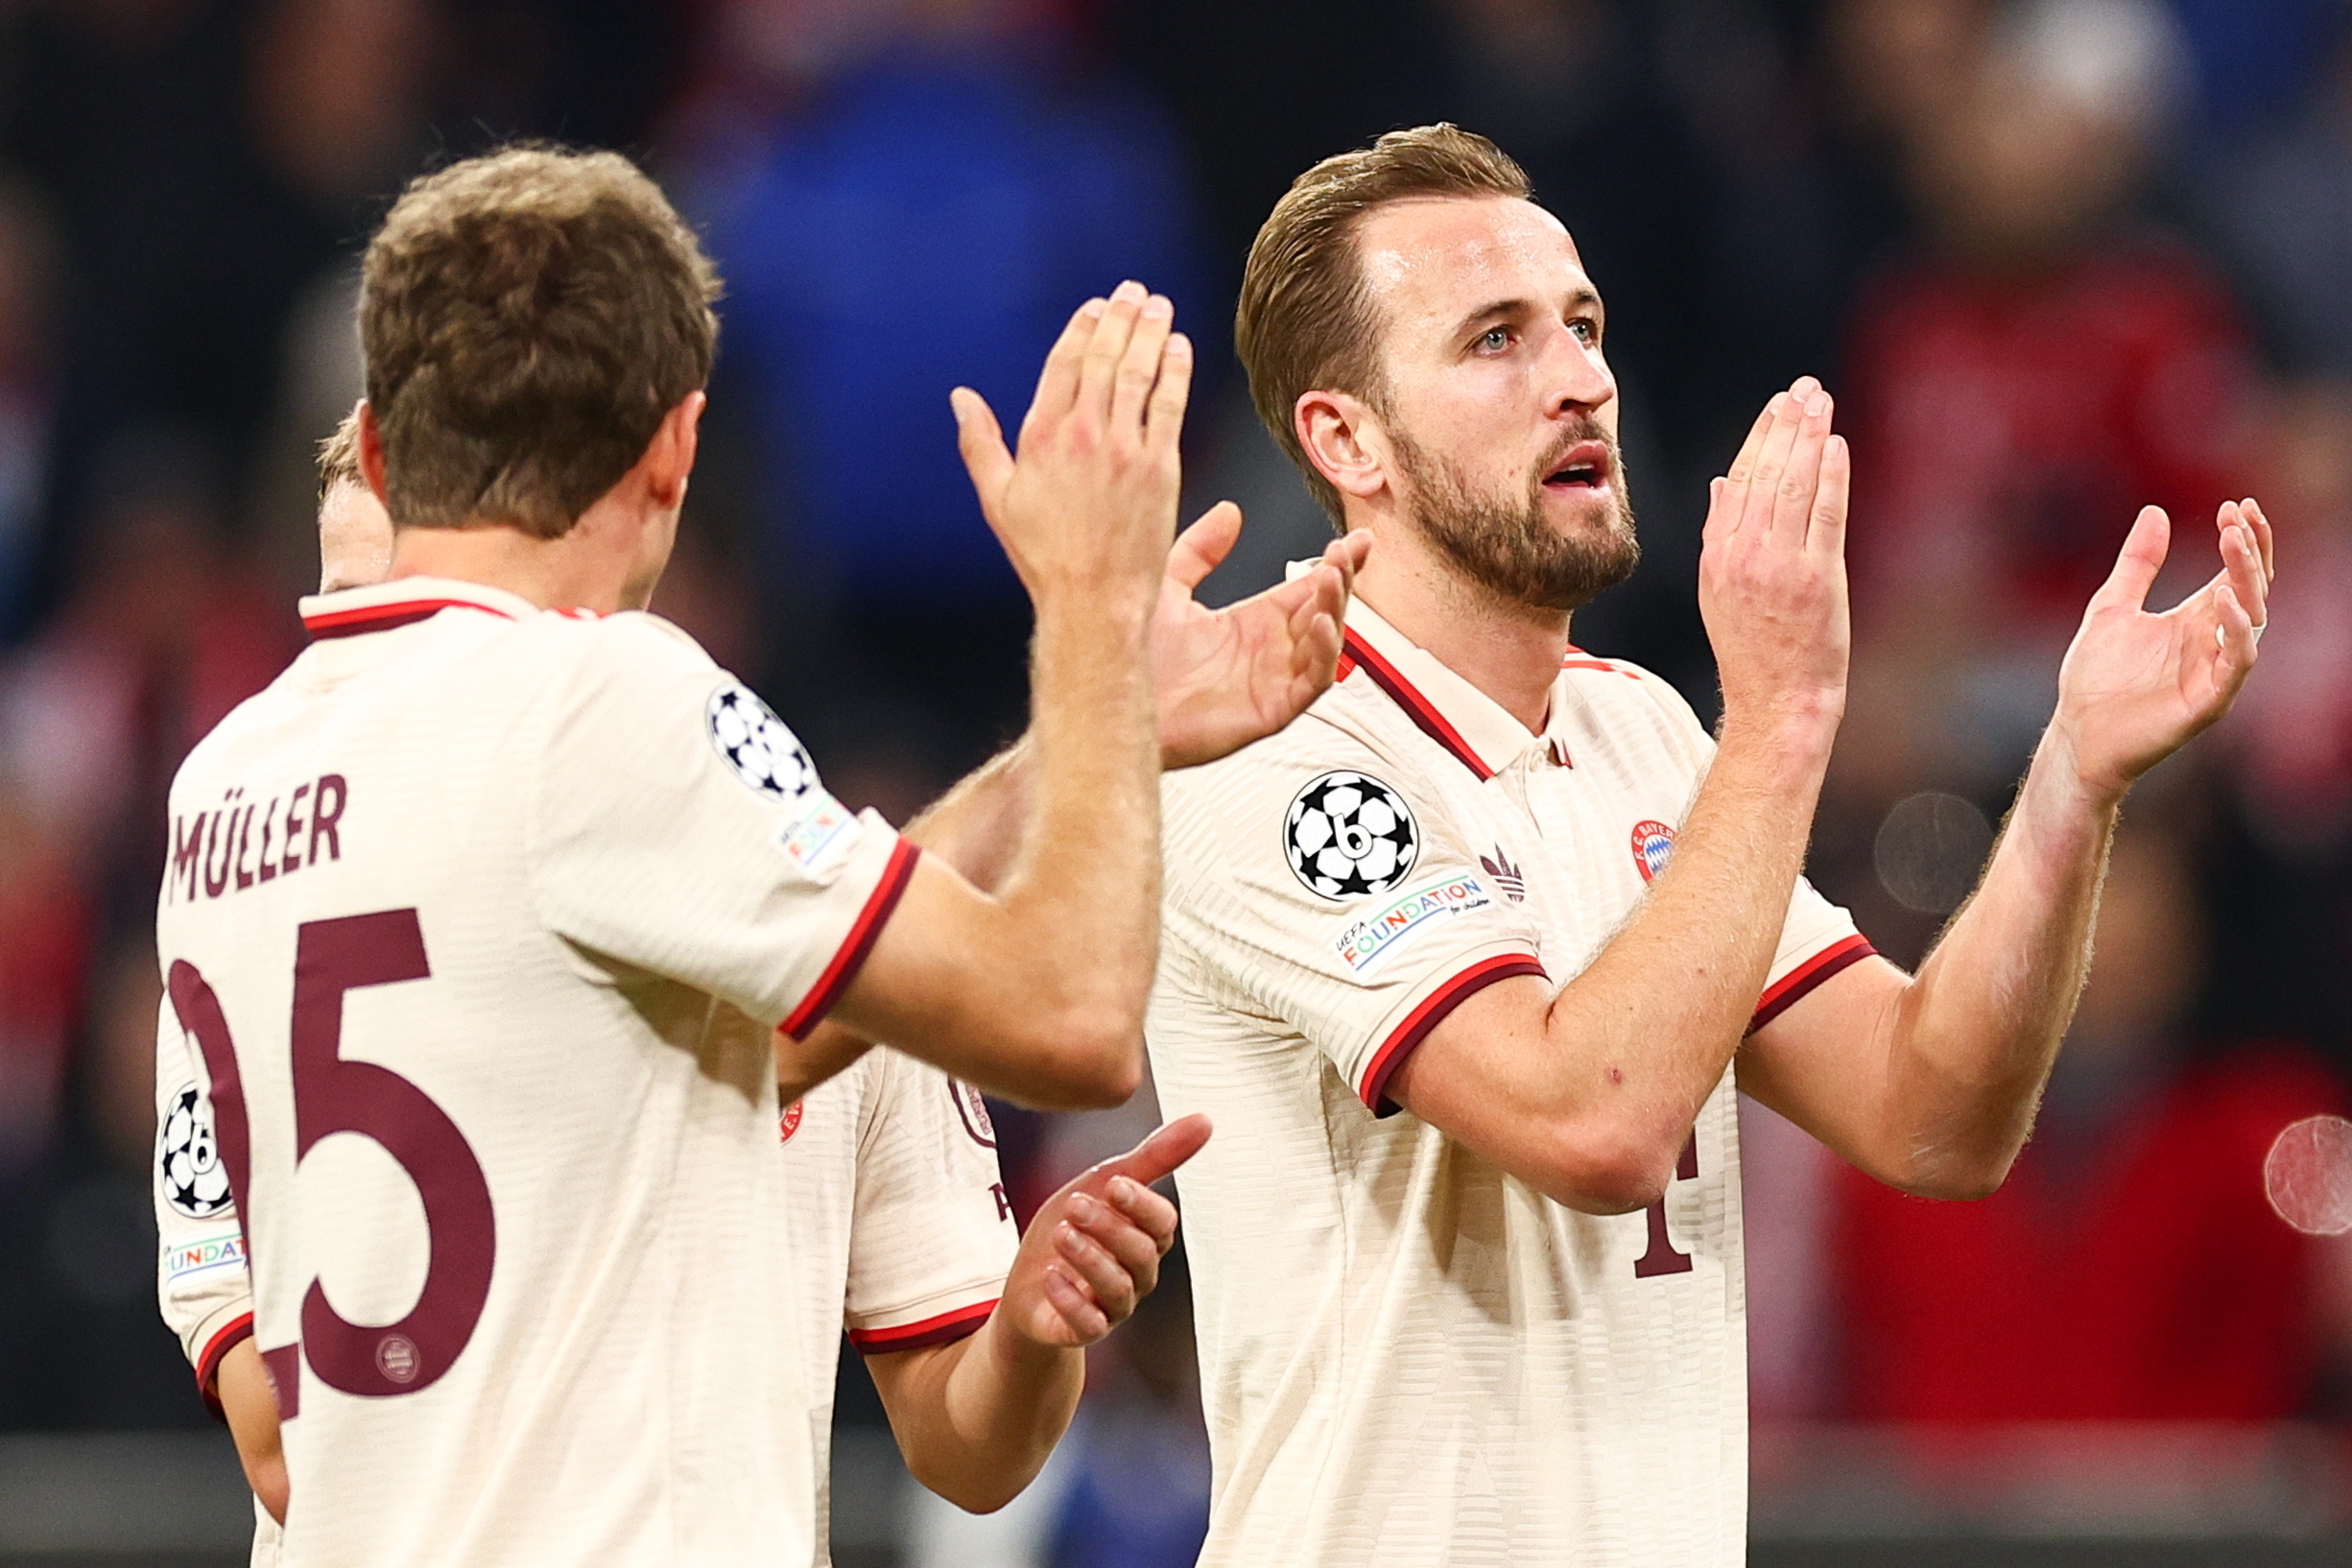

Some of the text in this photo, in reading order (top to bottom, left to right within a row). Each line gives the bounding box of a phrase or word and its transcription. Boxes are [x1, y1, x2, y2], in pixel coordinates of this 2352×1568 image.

[168, 773, 347, 907] MÜLLER
[1333, 813, 1373, 860] 6
[1336, 921, 1366, 951] UEFA
[1343, 879, 1482, 966] FOUNDATION
[189, 1123, 218, 1175] 6
[166, 1239, 248, 1271] UNDAT
